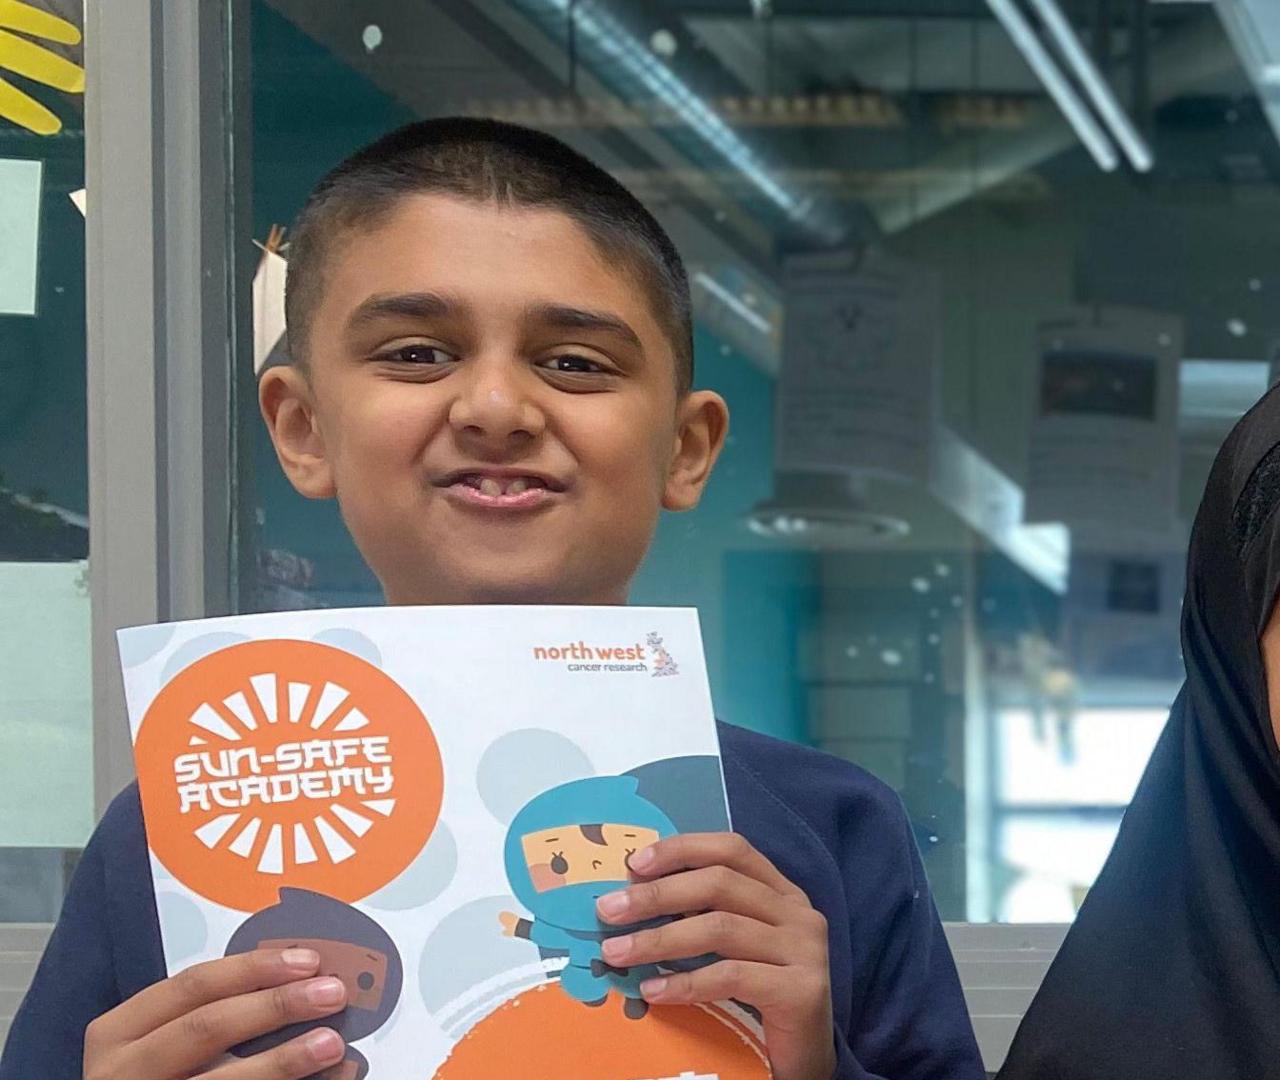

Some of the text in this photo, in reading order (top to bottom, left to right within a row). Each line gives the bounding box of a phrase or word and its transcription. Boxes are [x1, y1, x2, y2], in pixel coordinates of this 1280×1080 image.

[533, 641, 646, 661] north west
[567, 662, 648, 672] cancer research
[173, 735, 393, 783] SUN-SAFE
[176, 766, 395, 814] ACADEMY
